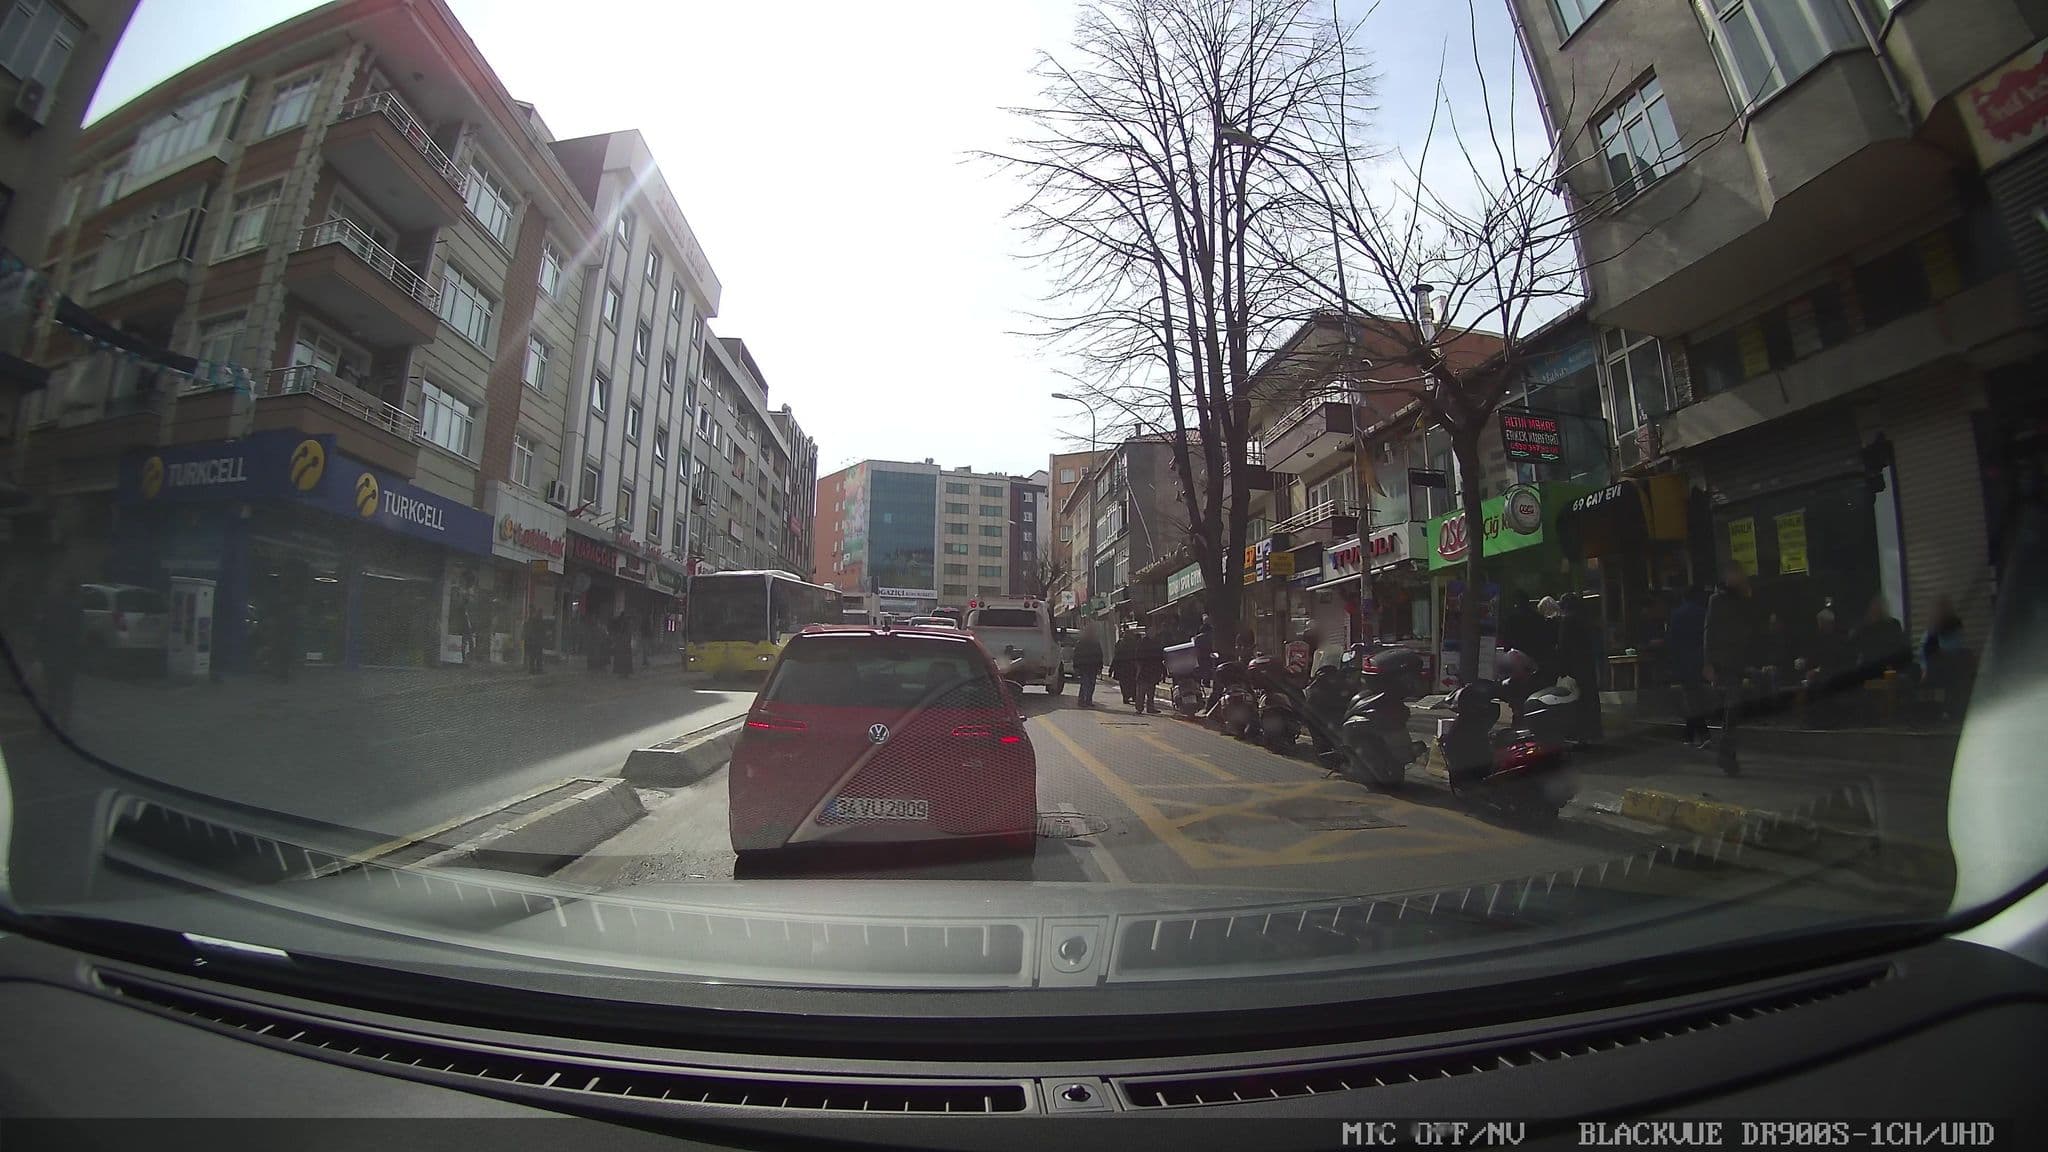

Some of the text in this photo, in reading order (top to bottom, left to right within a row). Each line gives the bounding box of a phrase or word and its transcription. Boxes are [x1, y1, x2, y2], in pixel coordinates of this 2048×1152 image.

[168, 456, 247, 486] TURKCELL
[383, 489, 446, 531] TURKCELL
[1572, 498, 1585, 511] 69
